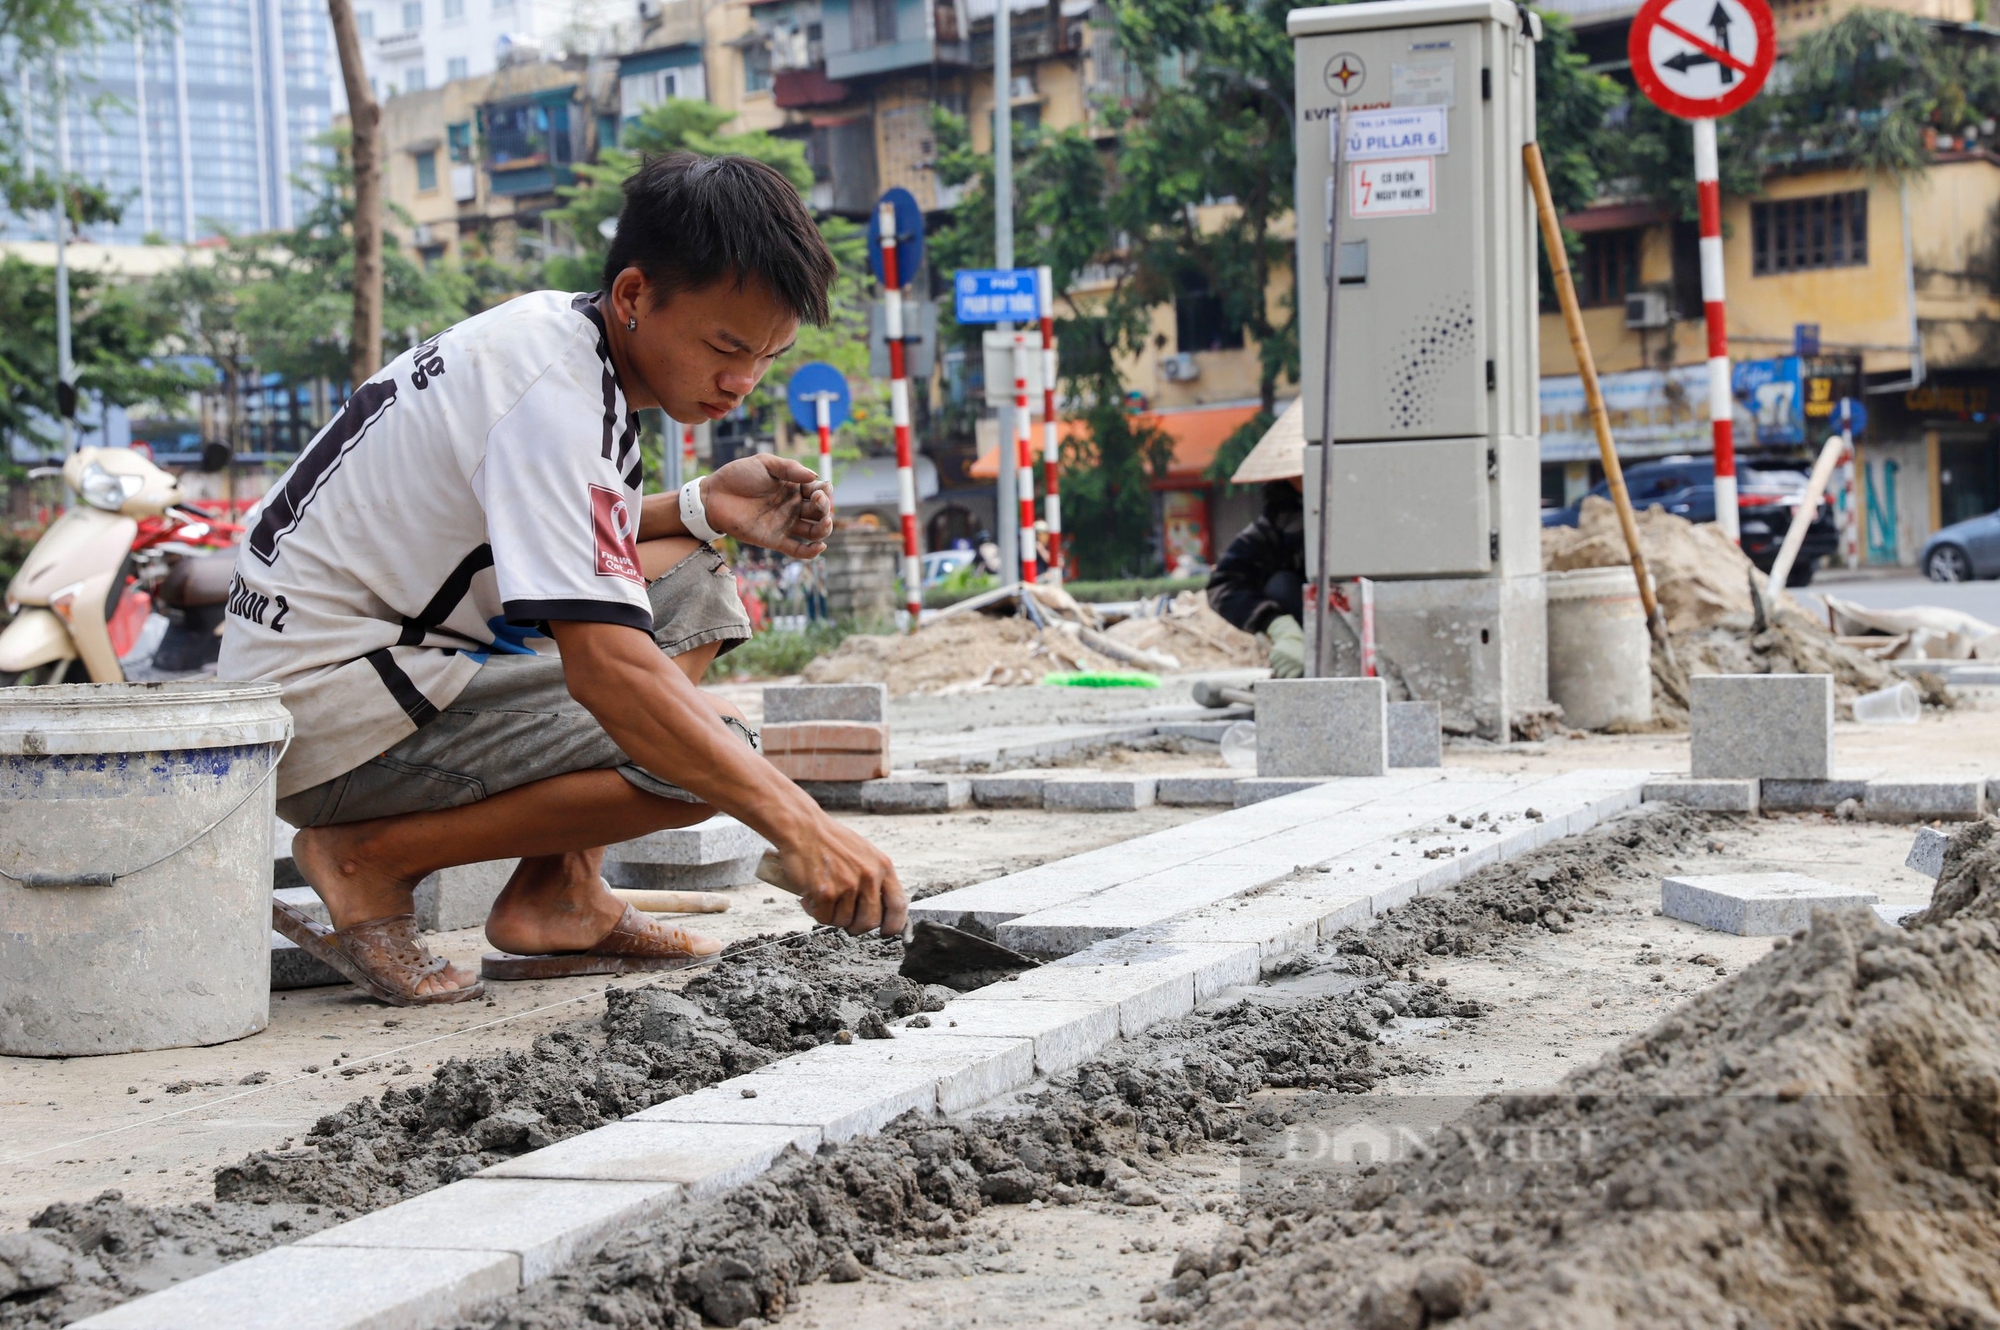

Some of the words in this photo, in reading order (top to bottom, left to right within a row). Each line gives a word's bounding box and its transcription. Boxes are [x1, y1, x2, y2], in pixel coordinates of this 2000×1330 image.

[1367, 133, 1422, 150] PILLAR
[1428, 132, 1437, 145] 6
[269, 594, 290, 633] 2
